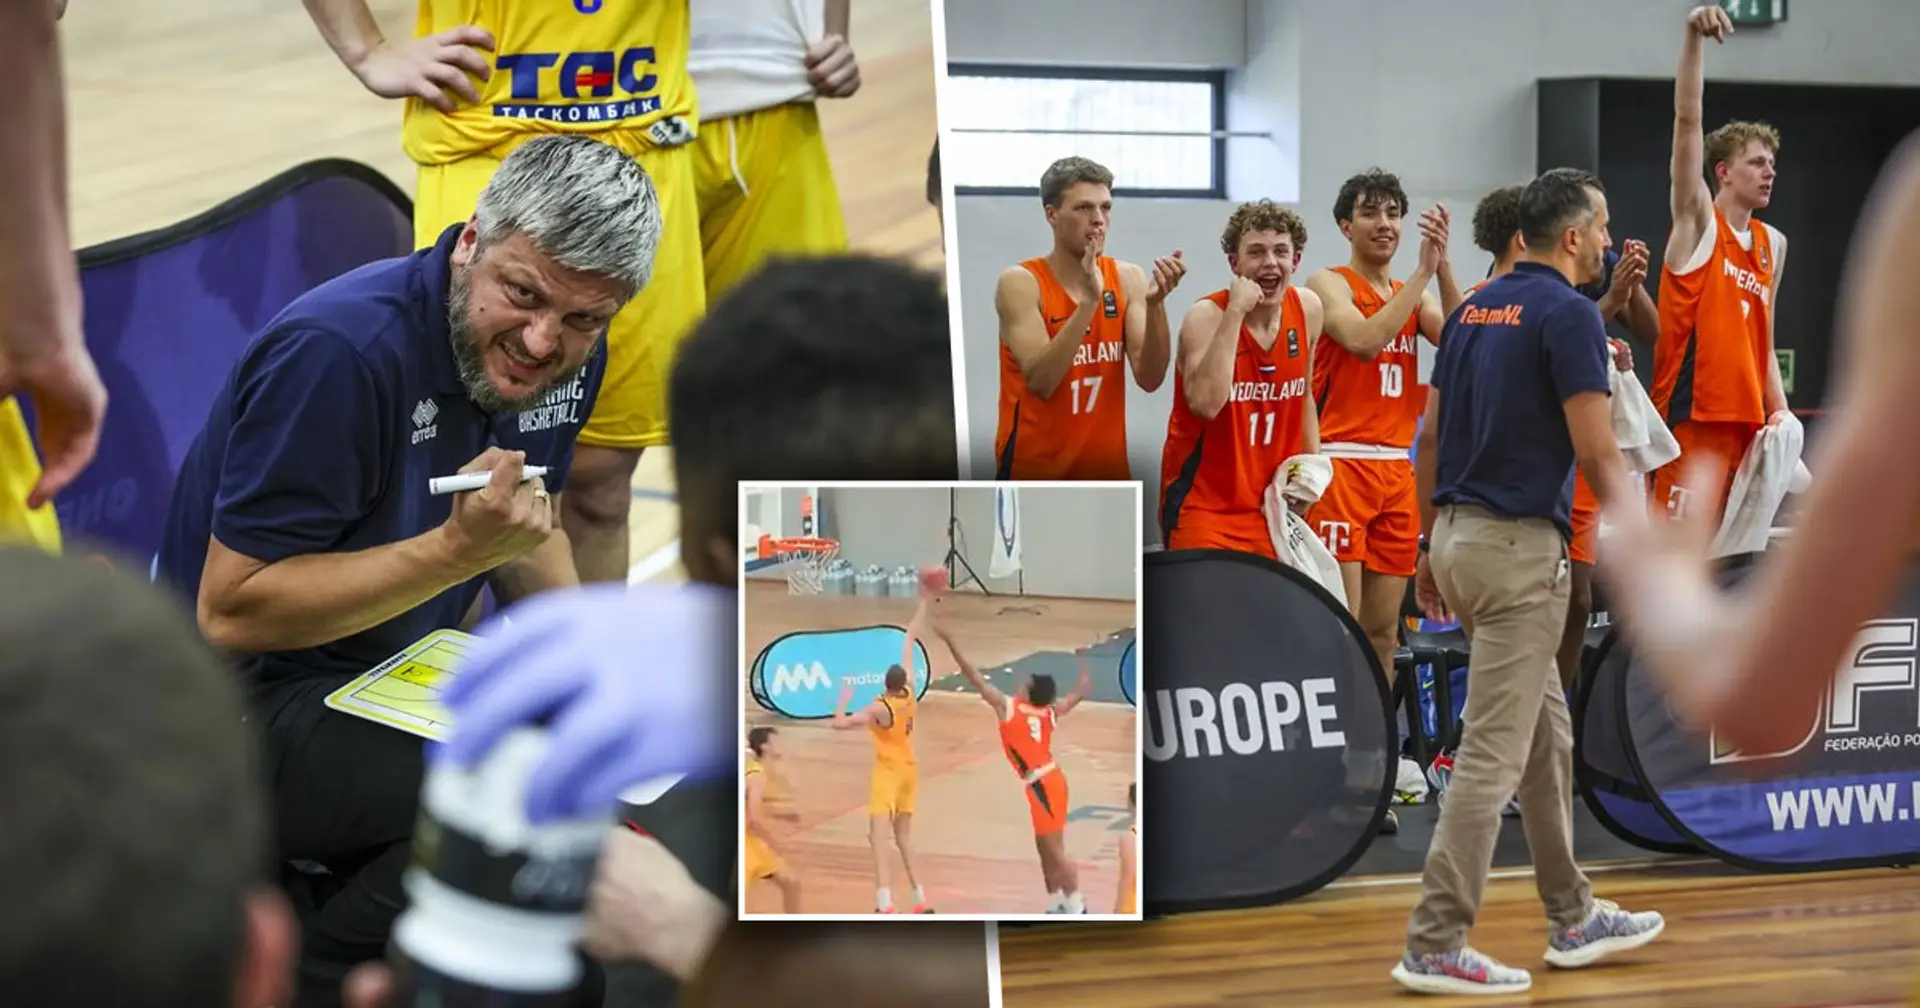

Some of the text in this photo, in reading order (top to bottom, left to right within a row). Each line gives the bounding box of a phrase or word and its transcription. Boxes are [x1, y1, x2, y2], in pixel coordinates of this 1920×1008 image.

[1460, 304, 1523, 326] TeamNL
[1070, 376, 1103, 415] 17
[1229, 377, 1305, 402] NEDERLAND
[1379, 363, 1403, 397] 10
[1249, 412, 1275, 447] 11
[1143, 678, 1346, 762] UROPE
[1824, 733, 1901, 751] FEDERAÇÃO
[1765, 781, 1920, 831] WWW.
